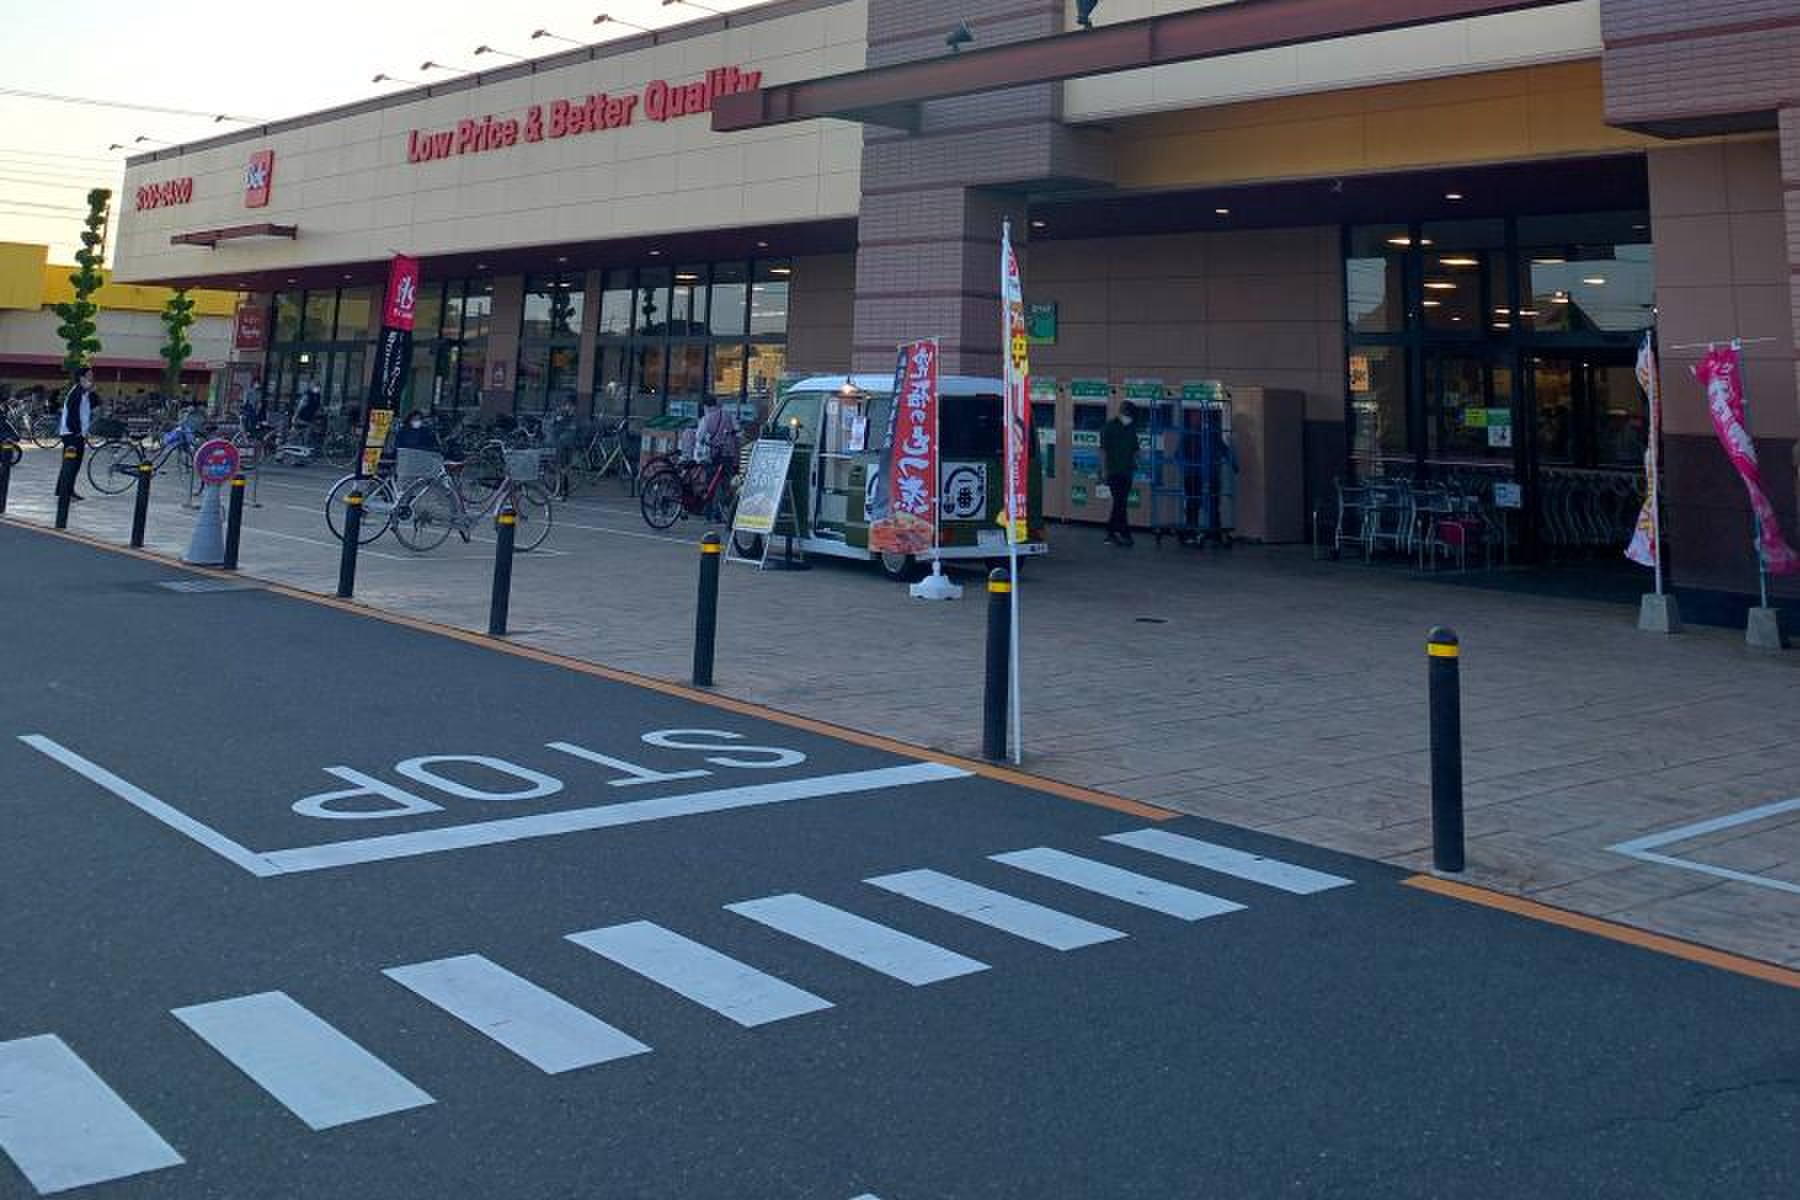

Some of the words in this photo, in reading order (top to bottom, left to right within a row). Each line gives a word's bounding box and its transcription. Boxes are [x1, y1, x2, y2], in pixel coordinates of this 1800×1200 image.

[407, 129, 454, 163] Low
[457, 115, 519, 154] Price
[523, 105, 544, 143] &
[549, 94, 639, 138] Better
[290, 728, 807, 819] STOP
